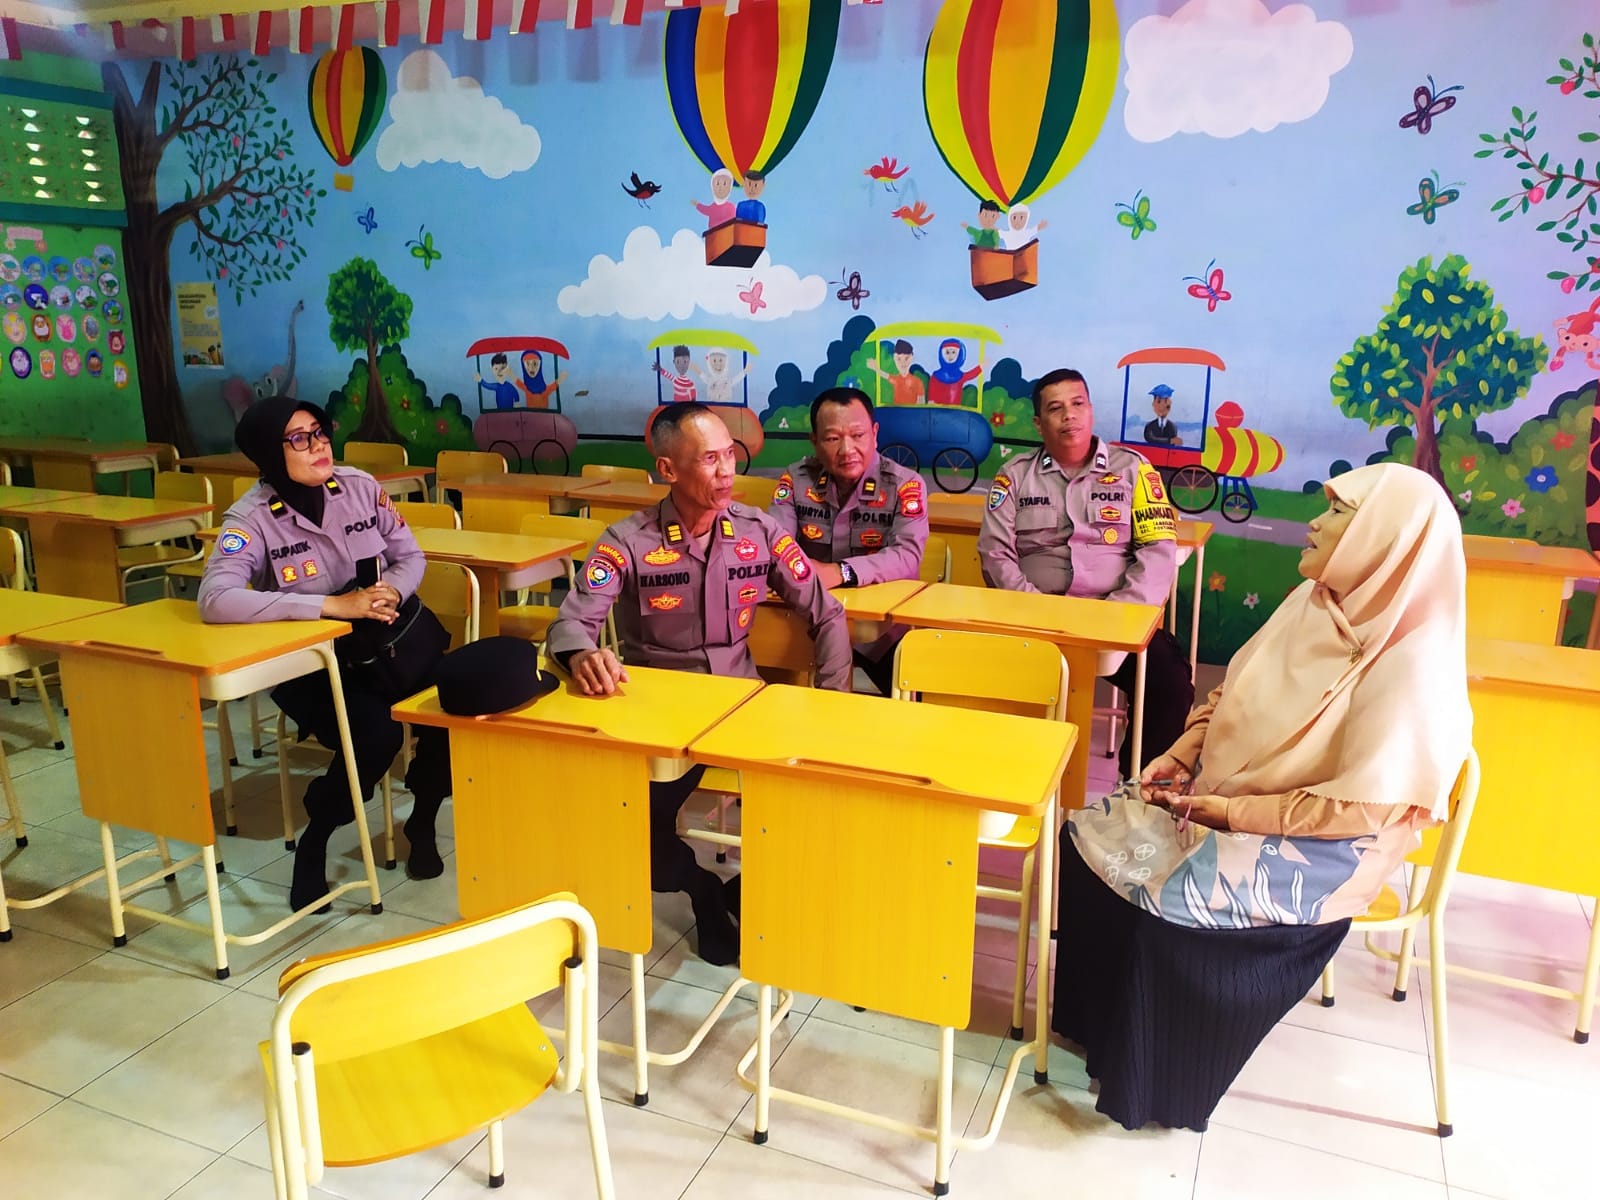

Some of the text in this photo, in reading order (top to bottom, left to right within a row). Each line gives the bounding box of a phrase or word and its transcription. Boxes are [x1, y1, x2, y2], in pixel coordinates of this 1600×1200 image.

[1019, 497, 1051, 507] SYAIFUL
[1090, 491, 1125, 503] POLRI
[853, 512, 892, 527] POLRI
[640, 571, 690, 587] HARSONO
[728, 563, 769, 581] POLRI
